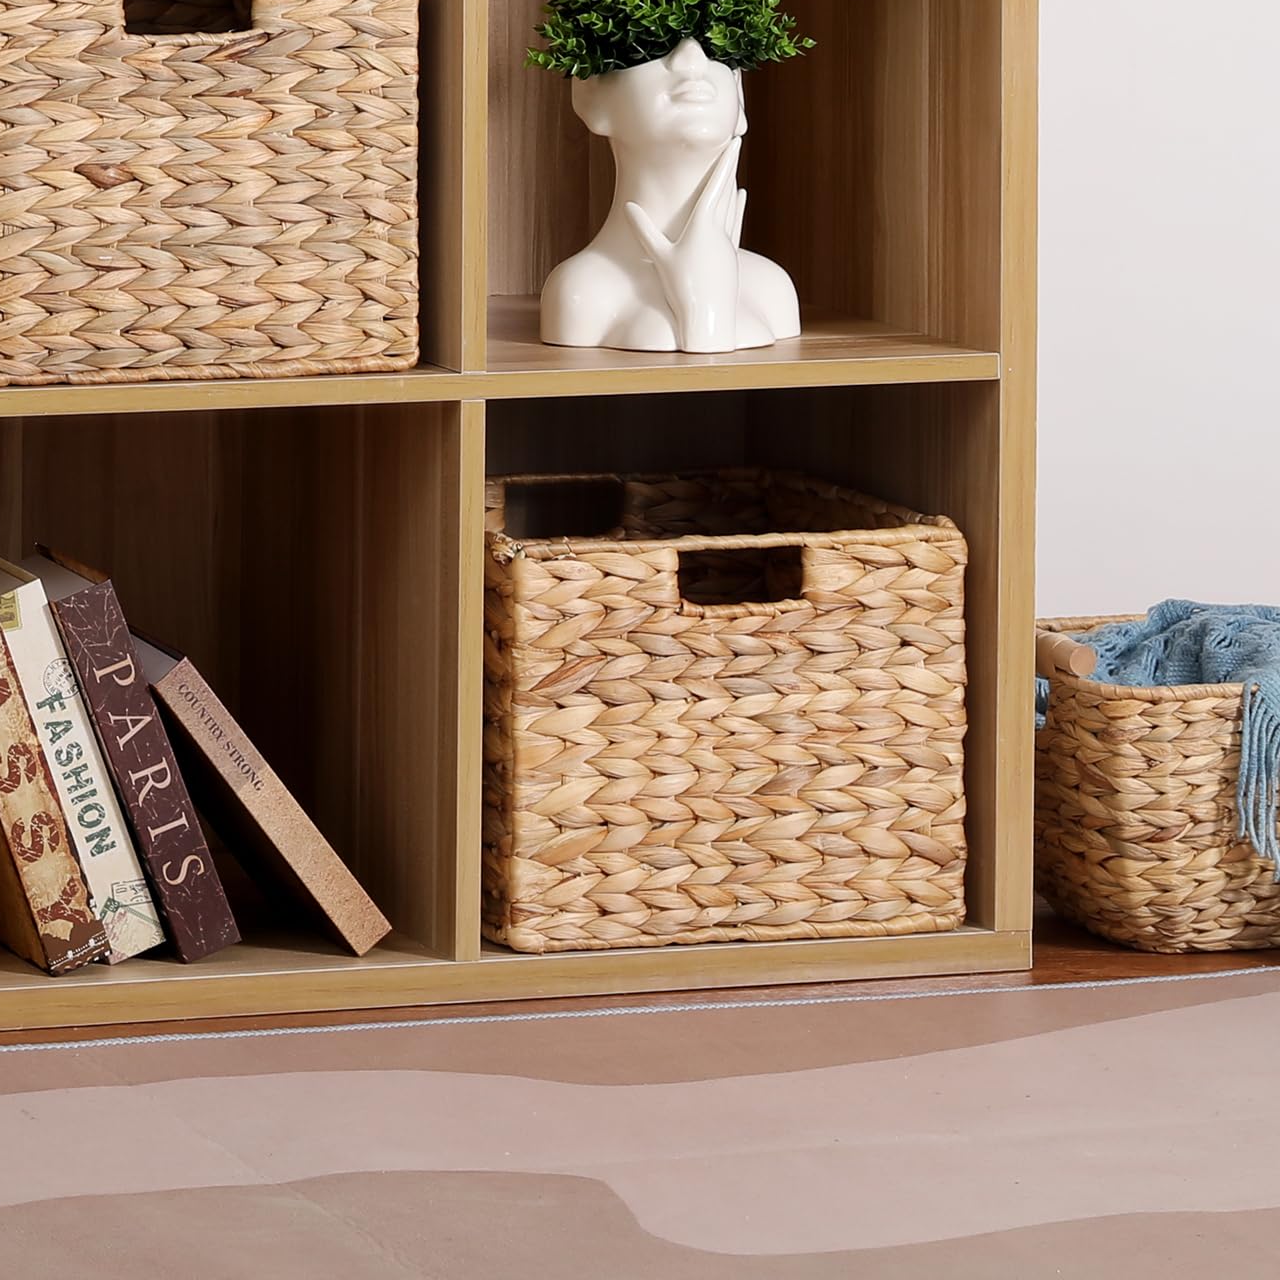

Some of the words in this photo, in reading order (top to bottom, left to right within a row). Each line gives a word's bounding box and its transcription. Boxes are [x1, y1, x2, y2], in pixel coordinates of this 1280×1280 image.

[36, 692, 118, 858] FASHION
[93, 655, 205, 888] PARIS
[178, 683, 226, 742] COUNTRY
[223, 741, 264, 791] STRONG
